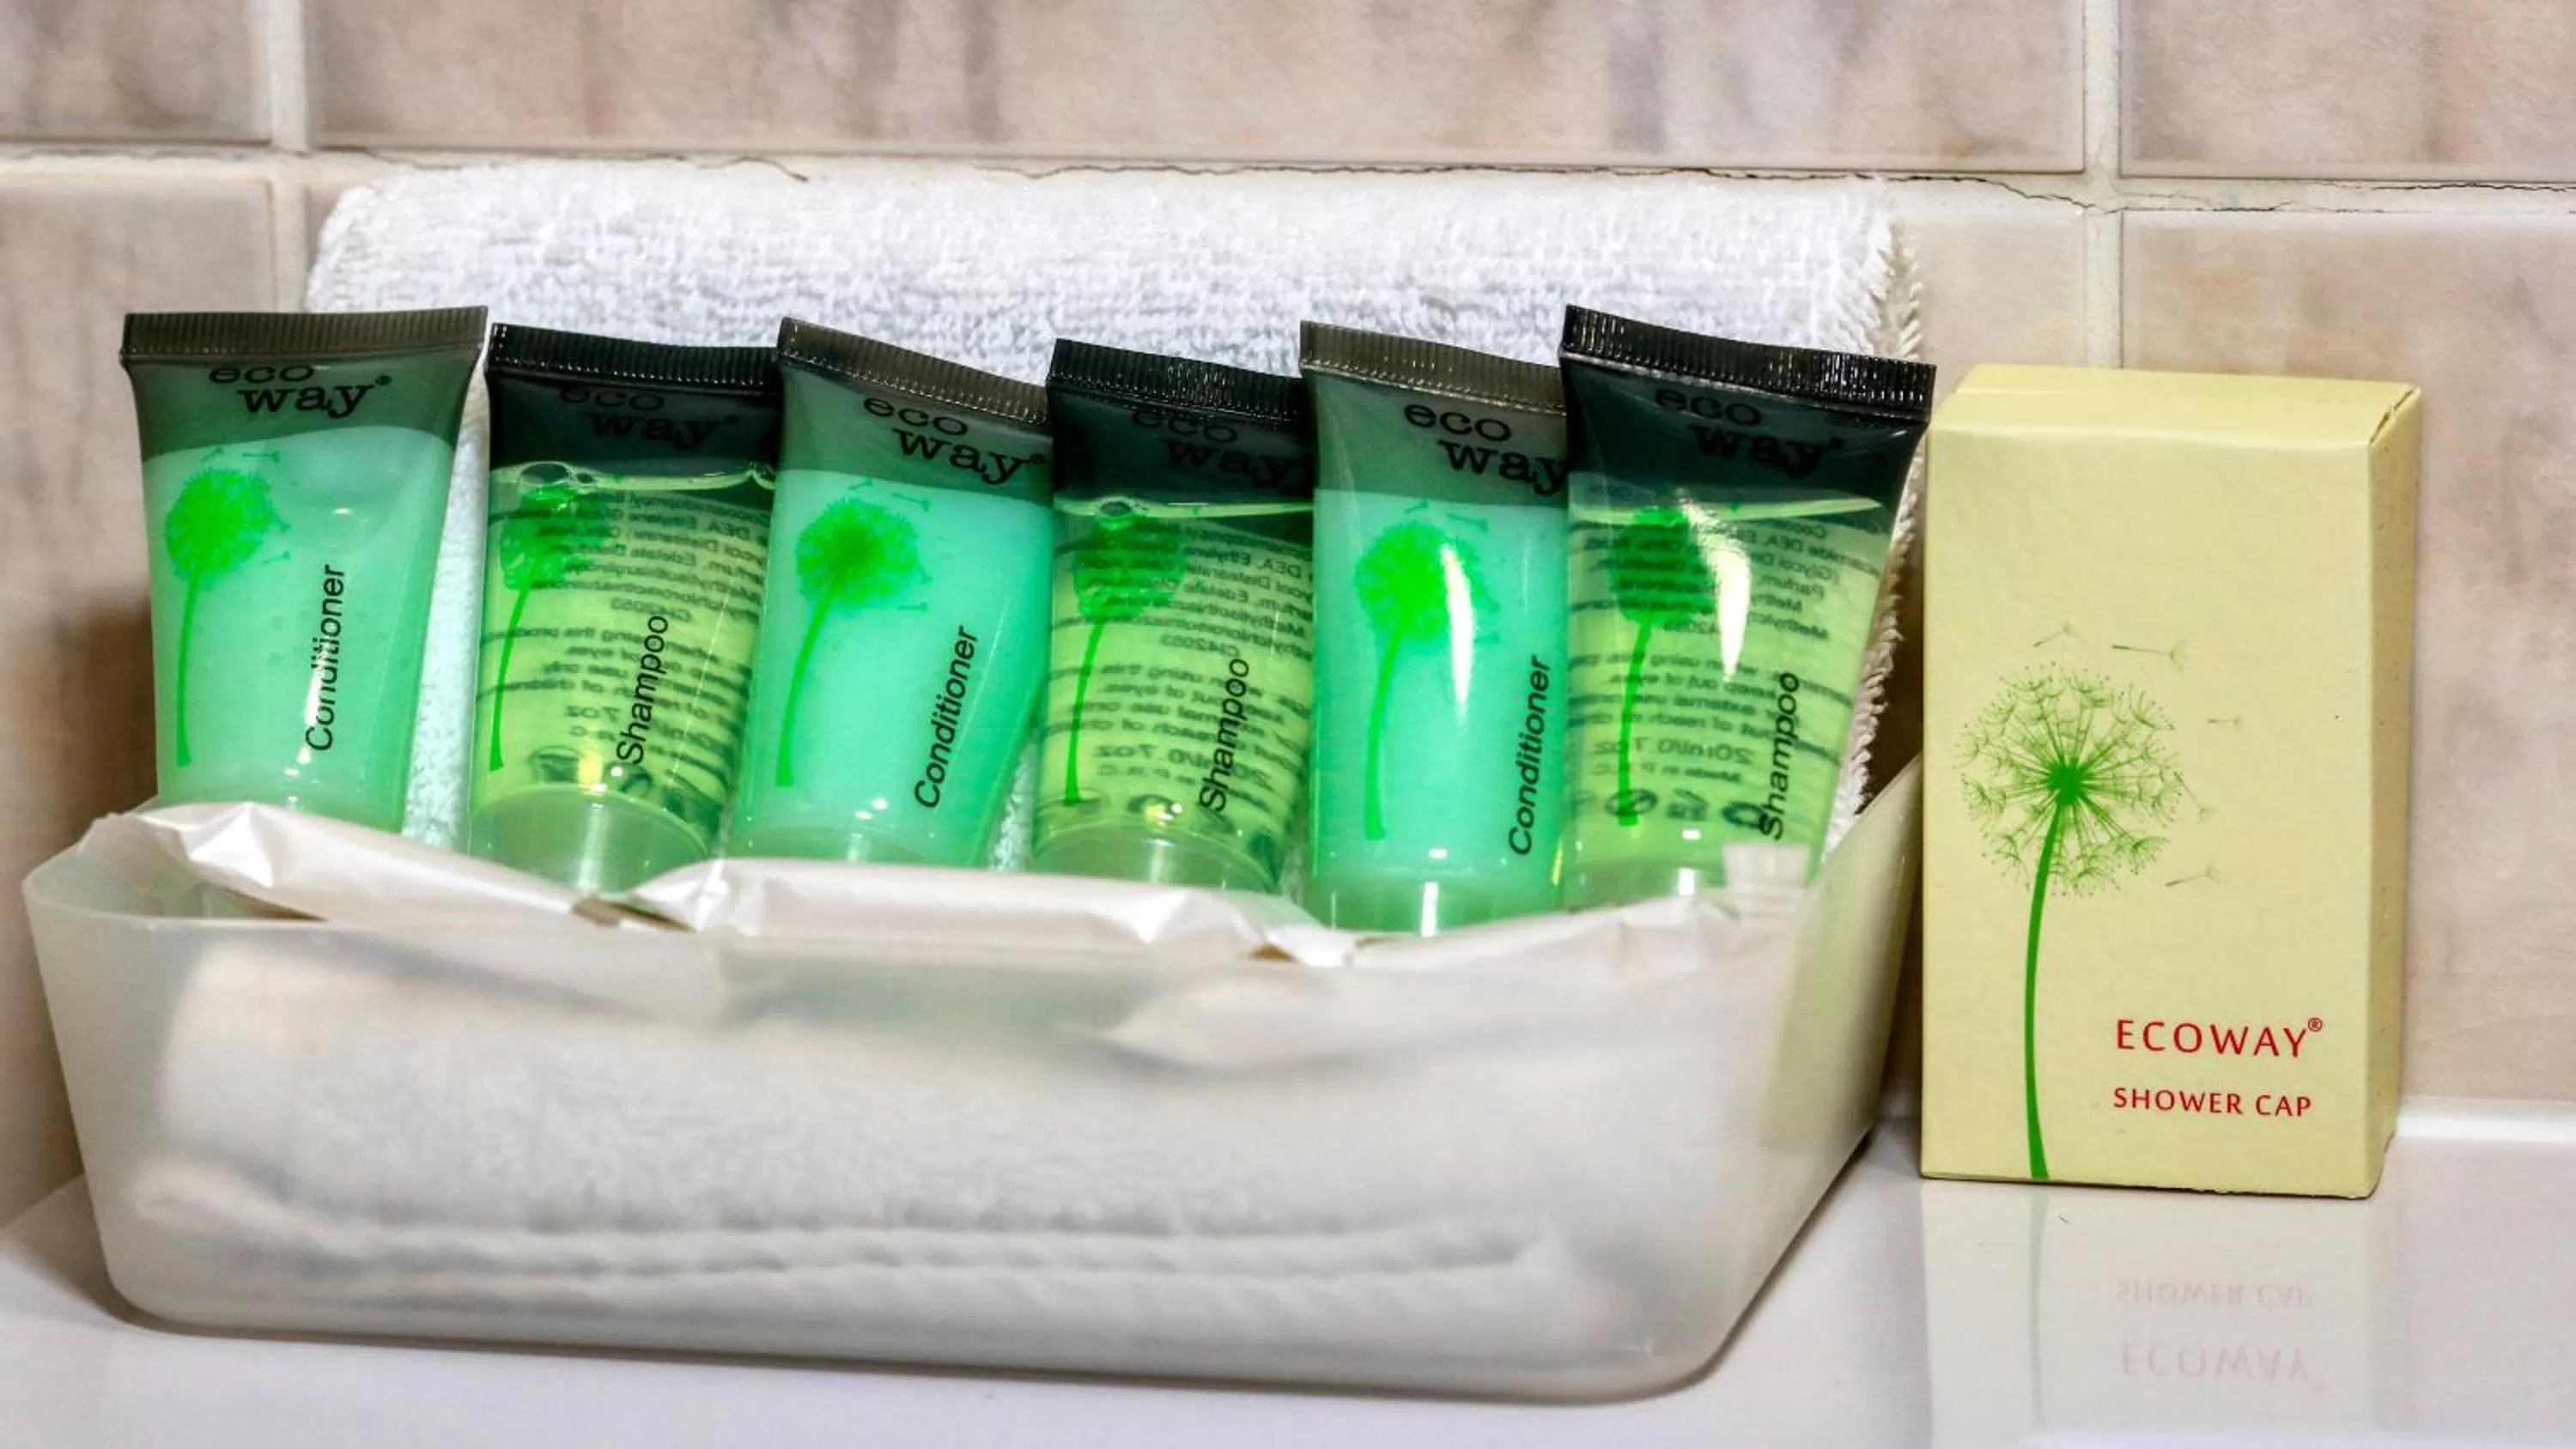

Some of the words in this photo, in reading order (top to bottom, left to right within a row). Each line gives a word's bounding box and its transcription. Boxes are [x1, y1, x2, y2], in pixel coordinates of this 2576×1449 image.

[209, 364, 314, 384] eco
[863, 397, 969, 437] eco
[1404, 403, 1512, 442] eco
[1655, 386, 1762, 427] eco
[304, 563, 345, 751] Conditioner
[615, 614, 669, 766] Shampoo
[914, 625, 979, 809] Conditioner
[1199, 658, 1249, 814] Shampoo
[1508, 654, 1553, 858] Conditioner
[1758, 670, 1801, 842] Shampoo
[2113, 1087, 2244, 1115] SHOWER
[2255, 1094, 2312, 1118] CAP
